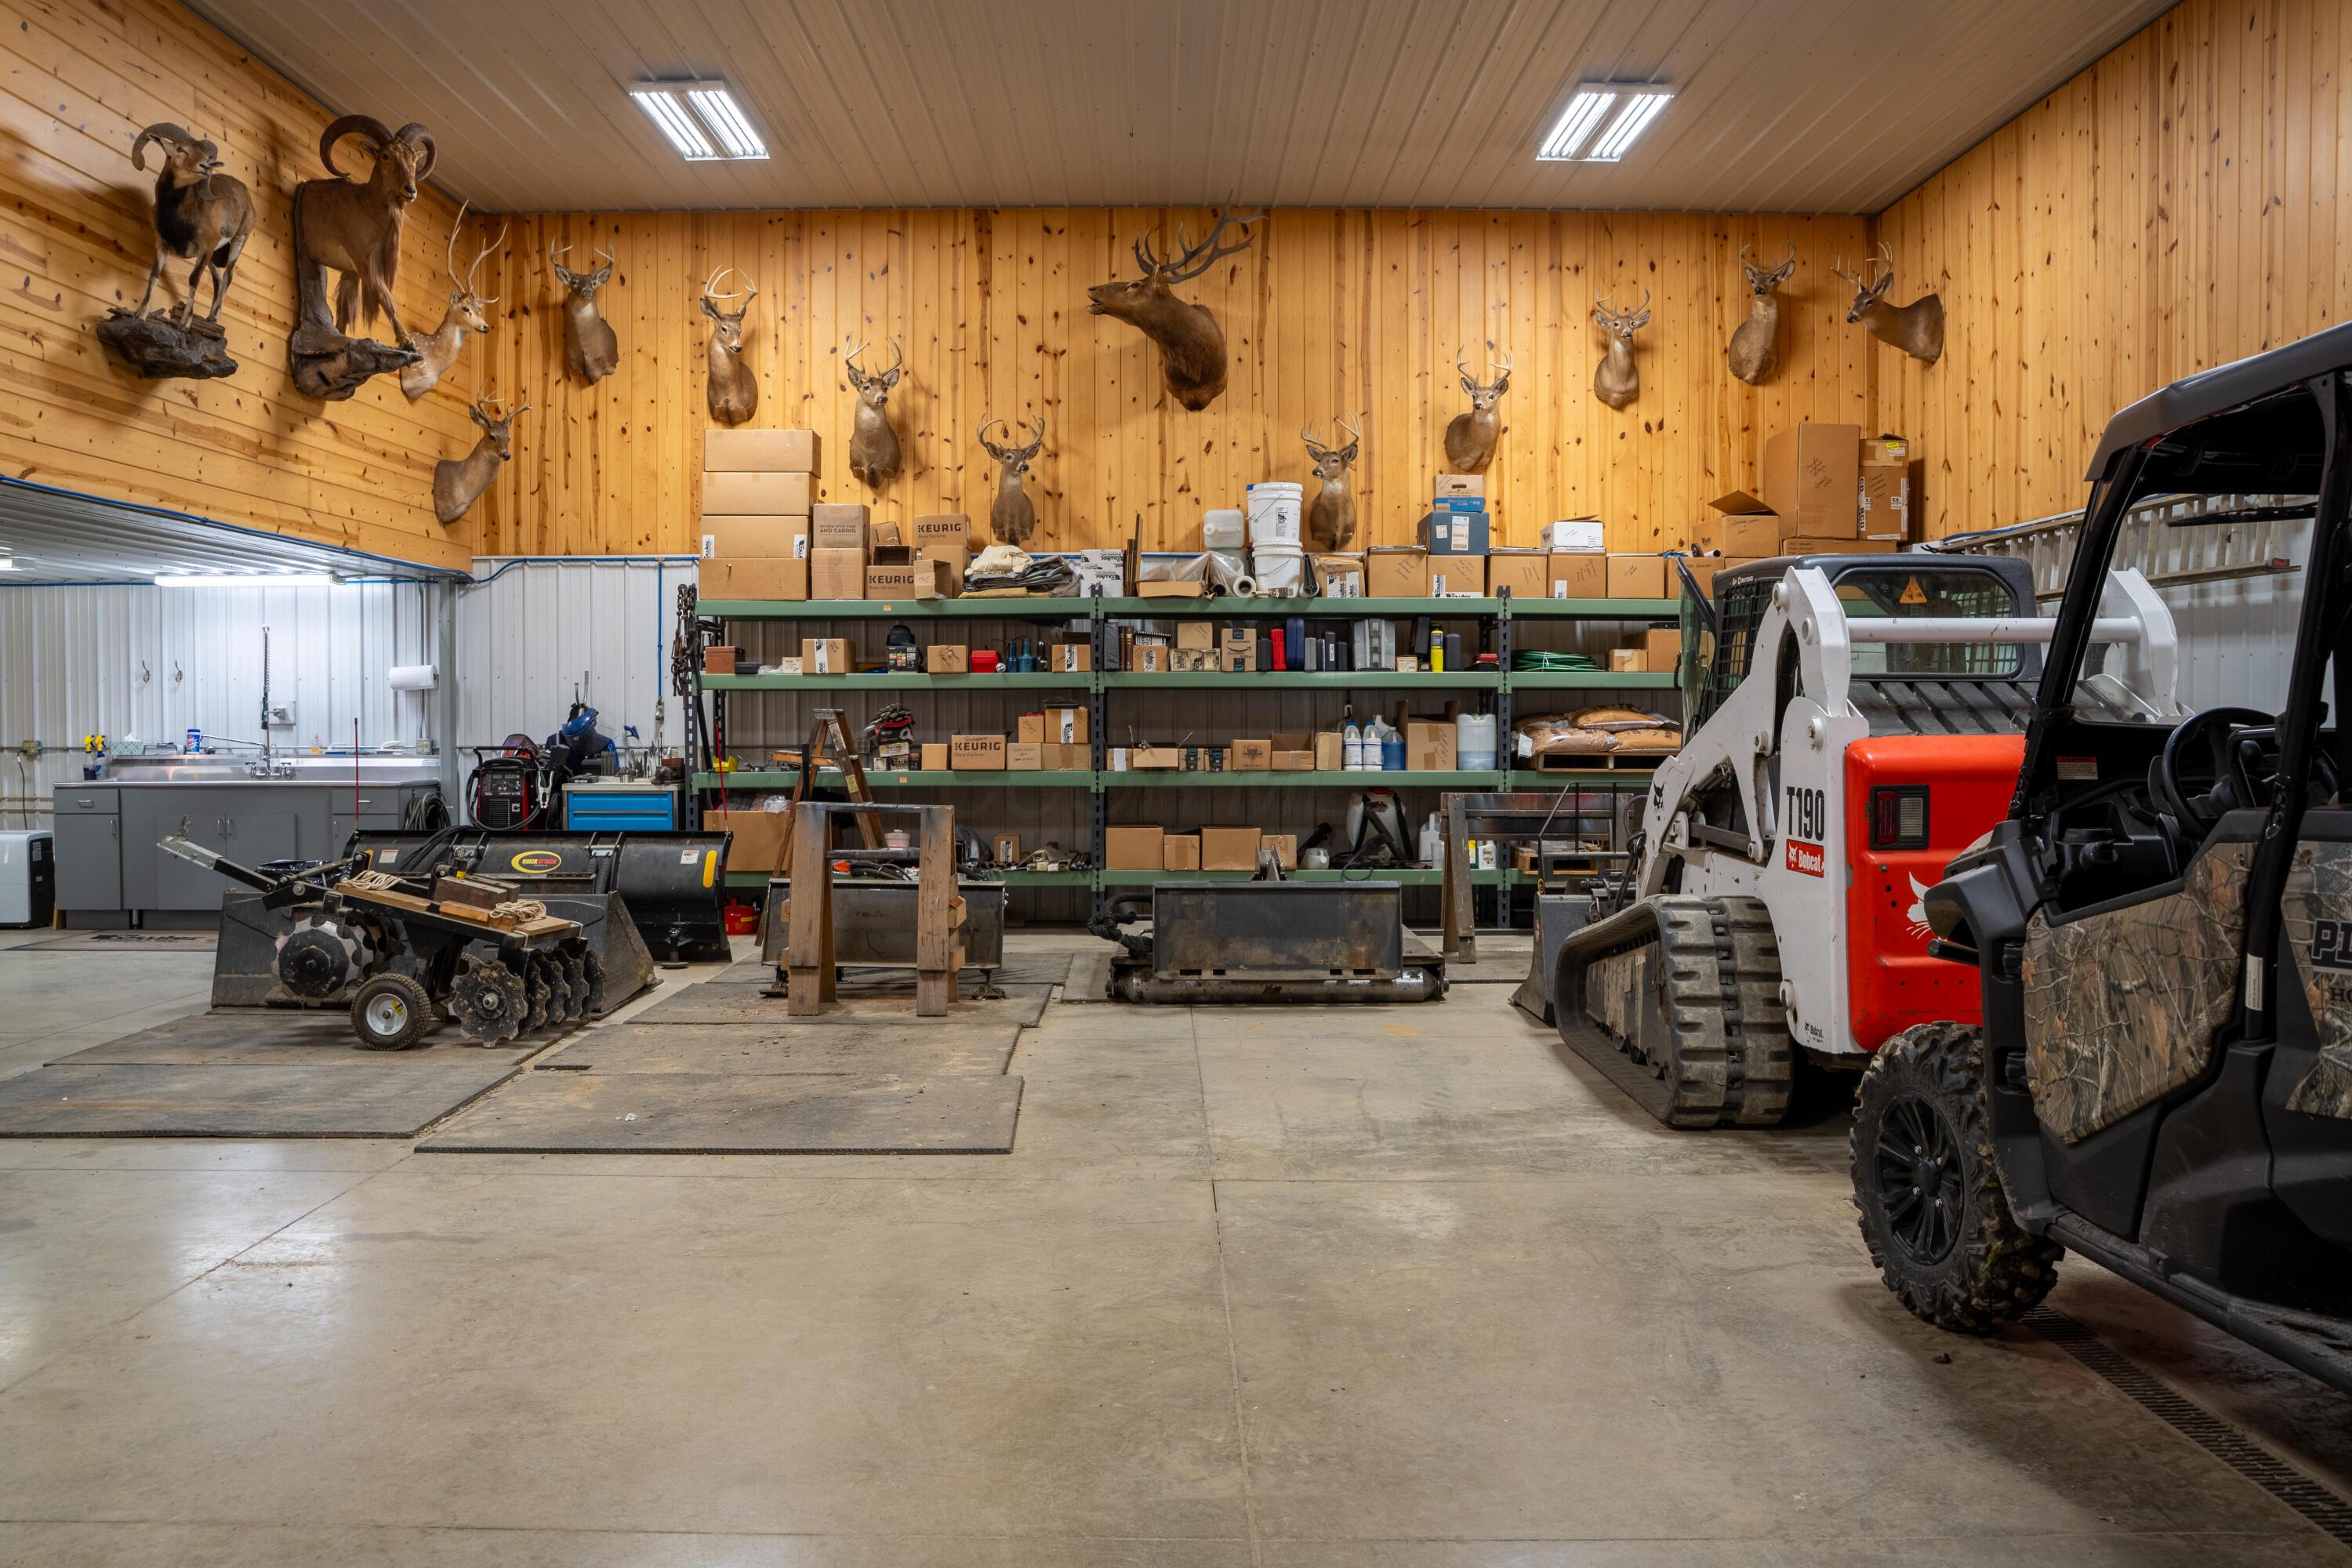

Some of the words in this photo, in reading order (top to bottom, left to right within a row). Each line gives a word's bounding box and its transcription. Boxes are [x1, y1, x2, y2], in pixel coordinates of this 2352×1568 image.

[918, 523, 961, 533] KEURIG
[869, 575, 914, 584] KEURIG
[955, 742, 1000, 751] KEURIG
[1786, 786, 1824, 841] T190
[1798, 849, 1820, 873] Bobcat
